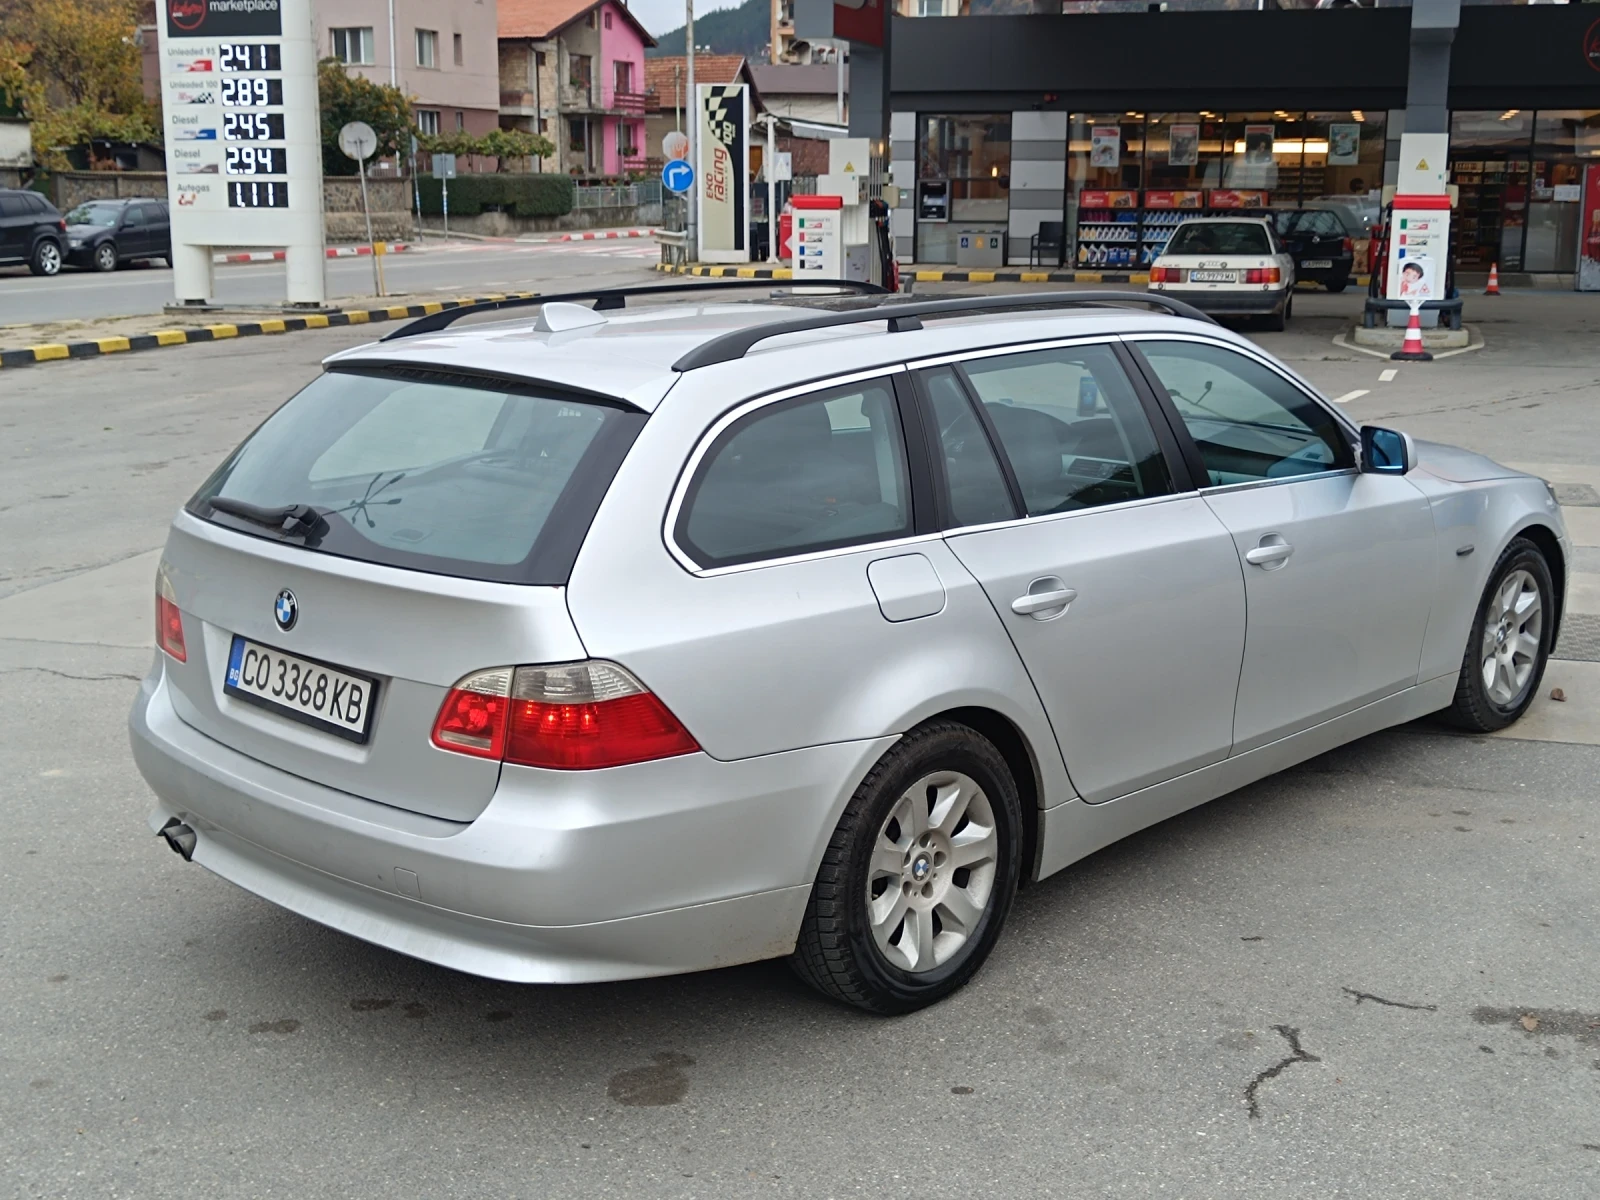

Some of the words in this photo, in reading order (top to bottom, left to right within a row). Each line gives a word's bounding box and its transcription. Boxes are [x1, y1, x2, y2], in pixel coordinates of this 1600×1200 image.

[209, 0, 279, 13] marketplace
[167, 48, 203, 56] Unleaded
[220, 44, 266, 72] 2.41
[170, 80, 203, 89] Unleaded
[206, 80, 218, 88] 100
[222, 78, 268, 106] 2.89
[172, 115, 198, 124] Diesel
[224, 113, 270, 140] 2.45
[723, 121, 732, 145] 100
[174, 149, 200, 158] Diesel
[226, 147, 272, 174] 2.94
[706, 172, 714, 199] EKO
[714, 148, 728, 202] racing
[177, 184, 210, 194] Autogas
[235, 183, 274, 207] 1.11
[229, 668, 238, 681] BG
